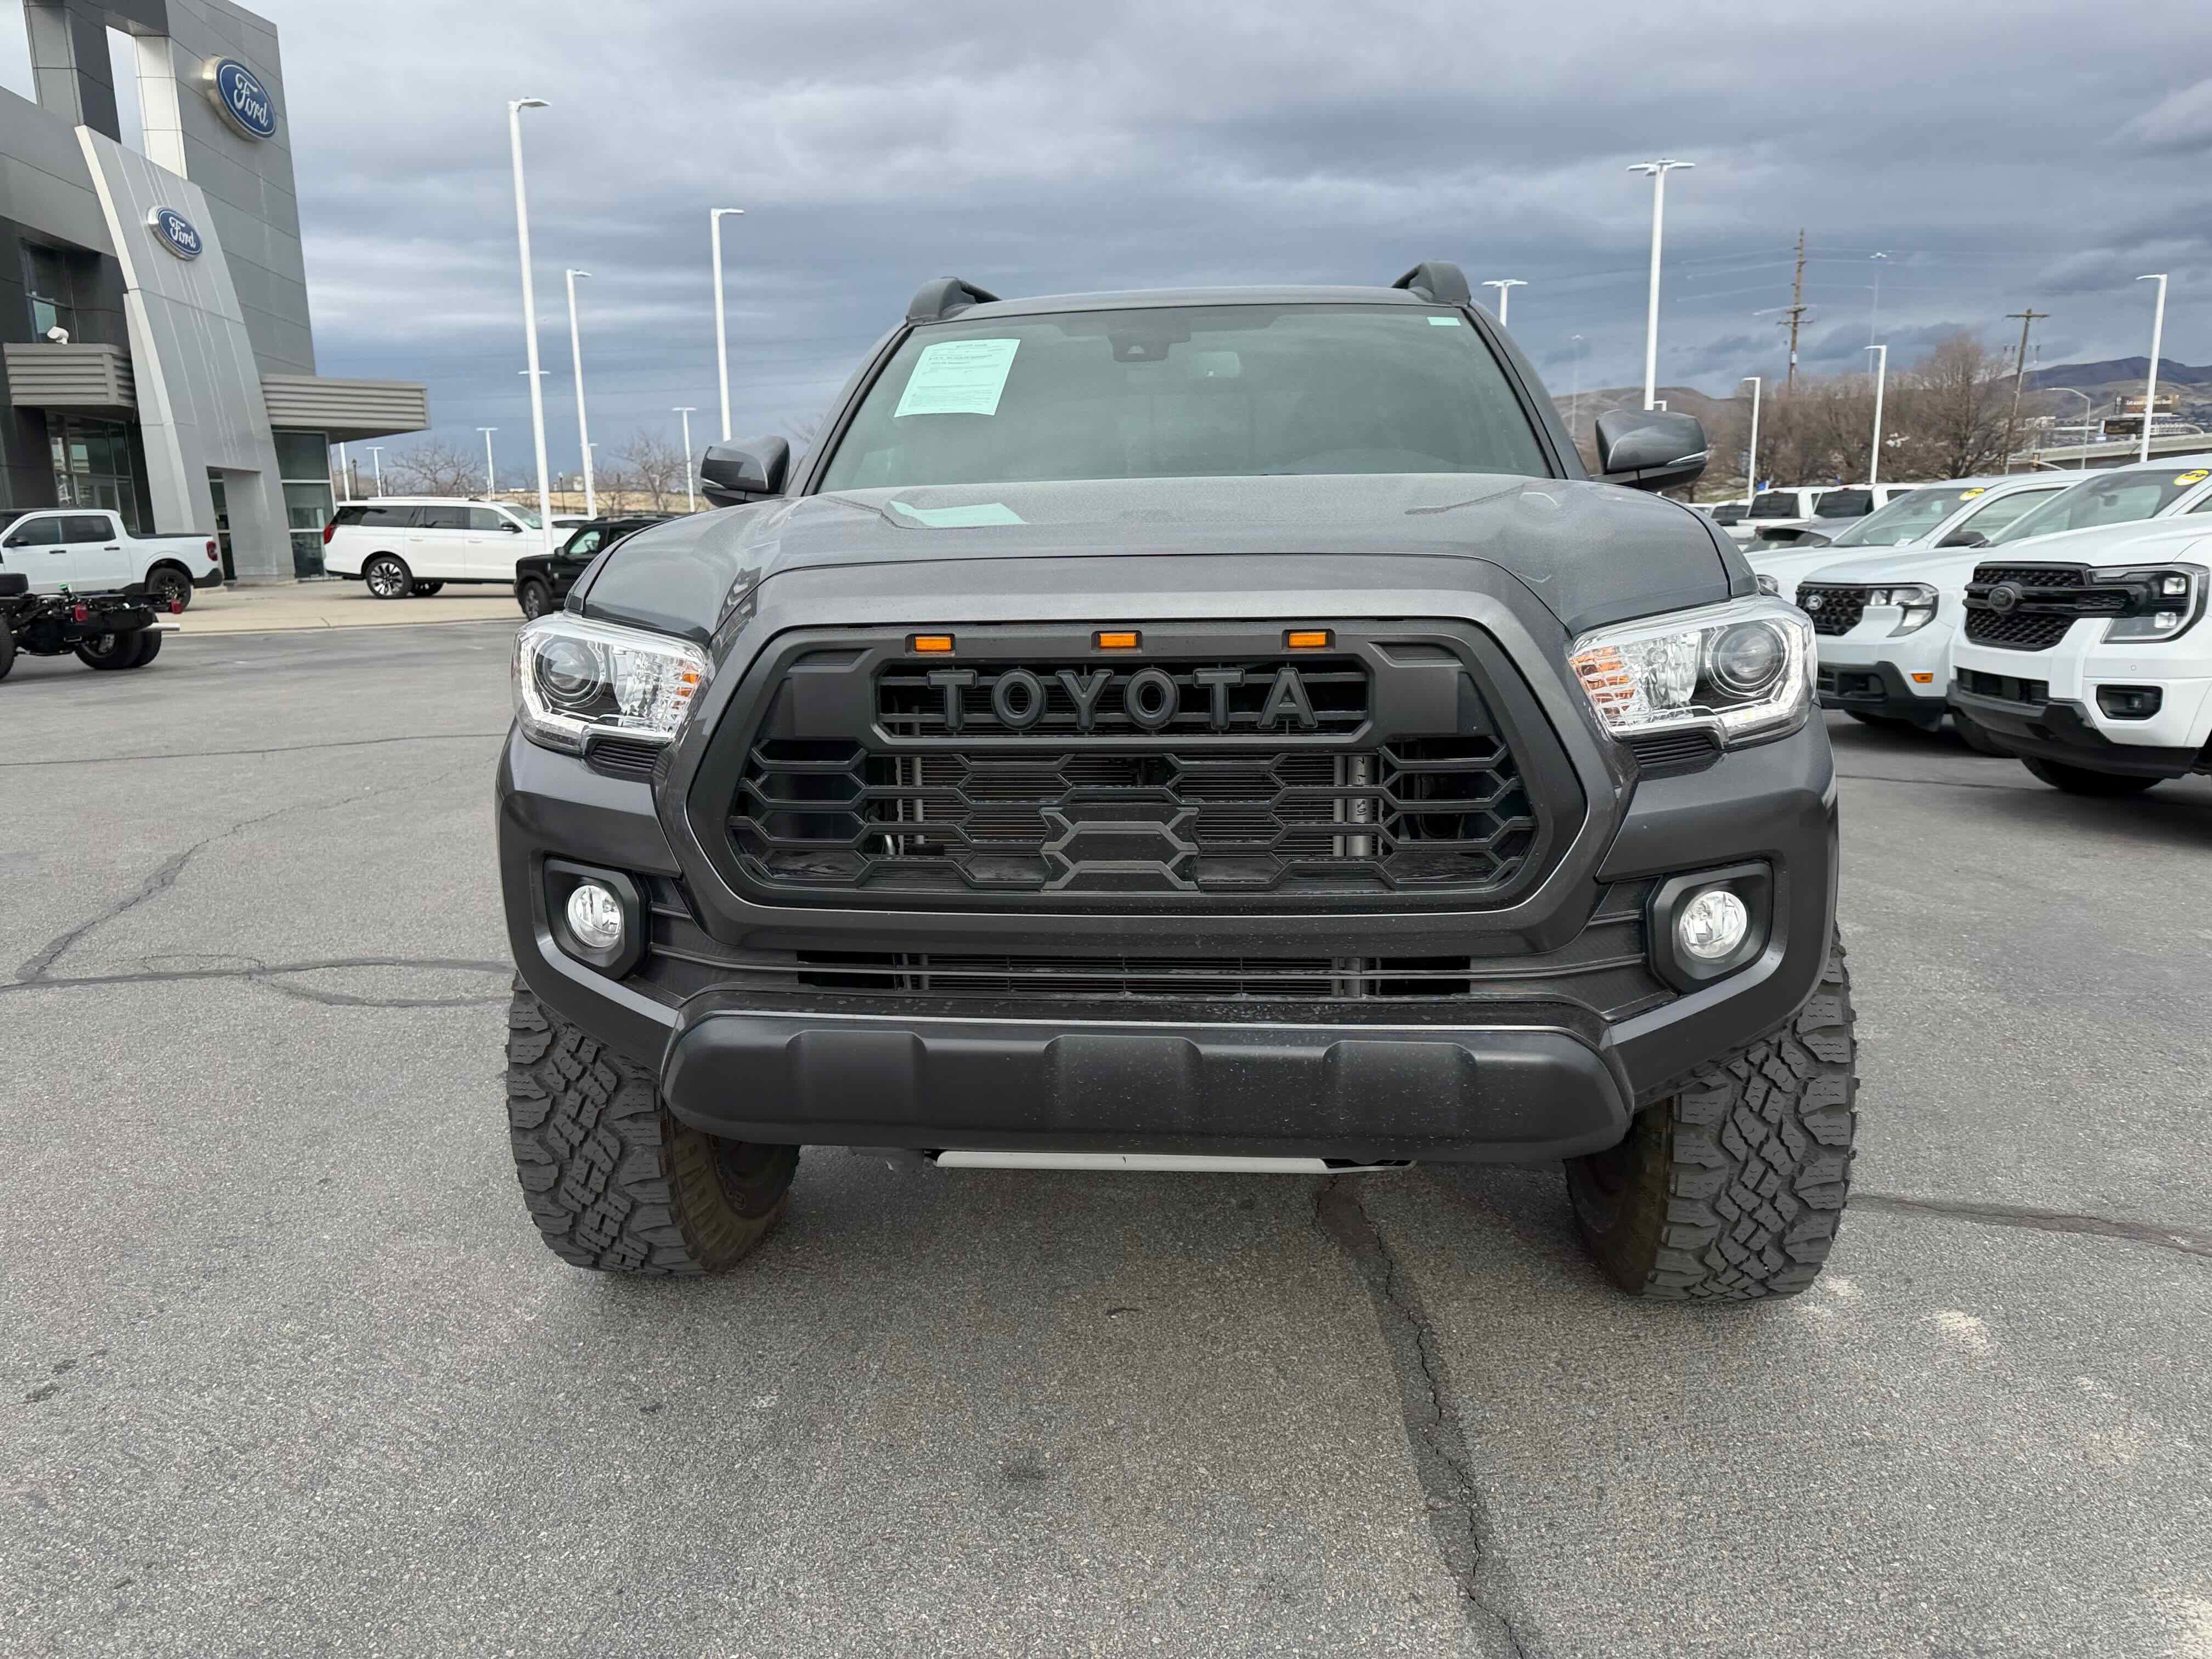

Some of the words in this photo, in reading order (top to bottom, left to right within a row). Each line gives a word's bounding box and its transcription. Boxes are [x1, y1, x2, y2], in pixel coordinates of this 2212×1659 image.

[234, 73, 268, 127] Ford
[169, 217, 196, 249] Ford
[927, 668, 1318, 730] TOYOTA
